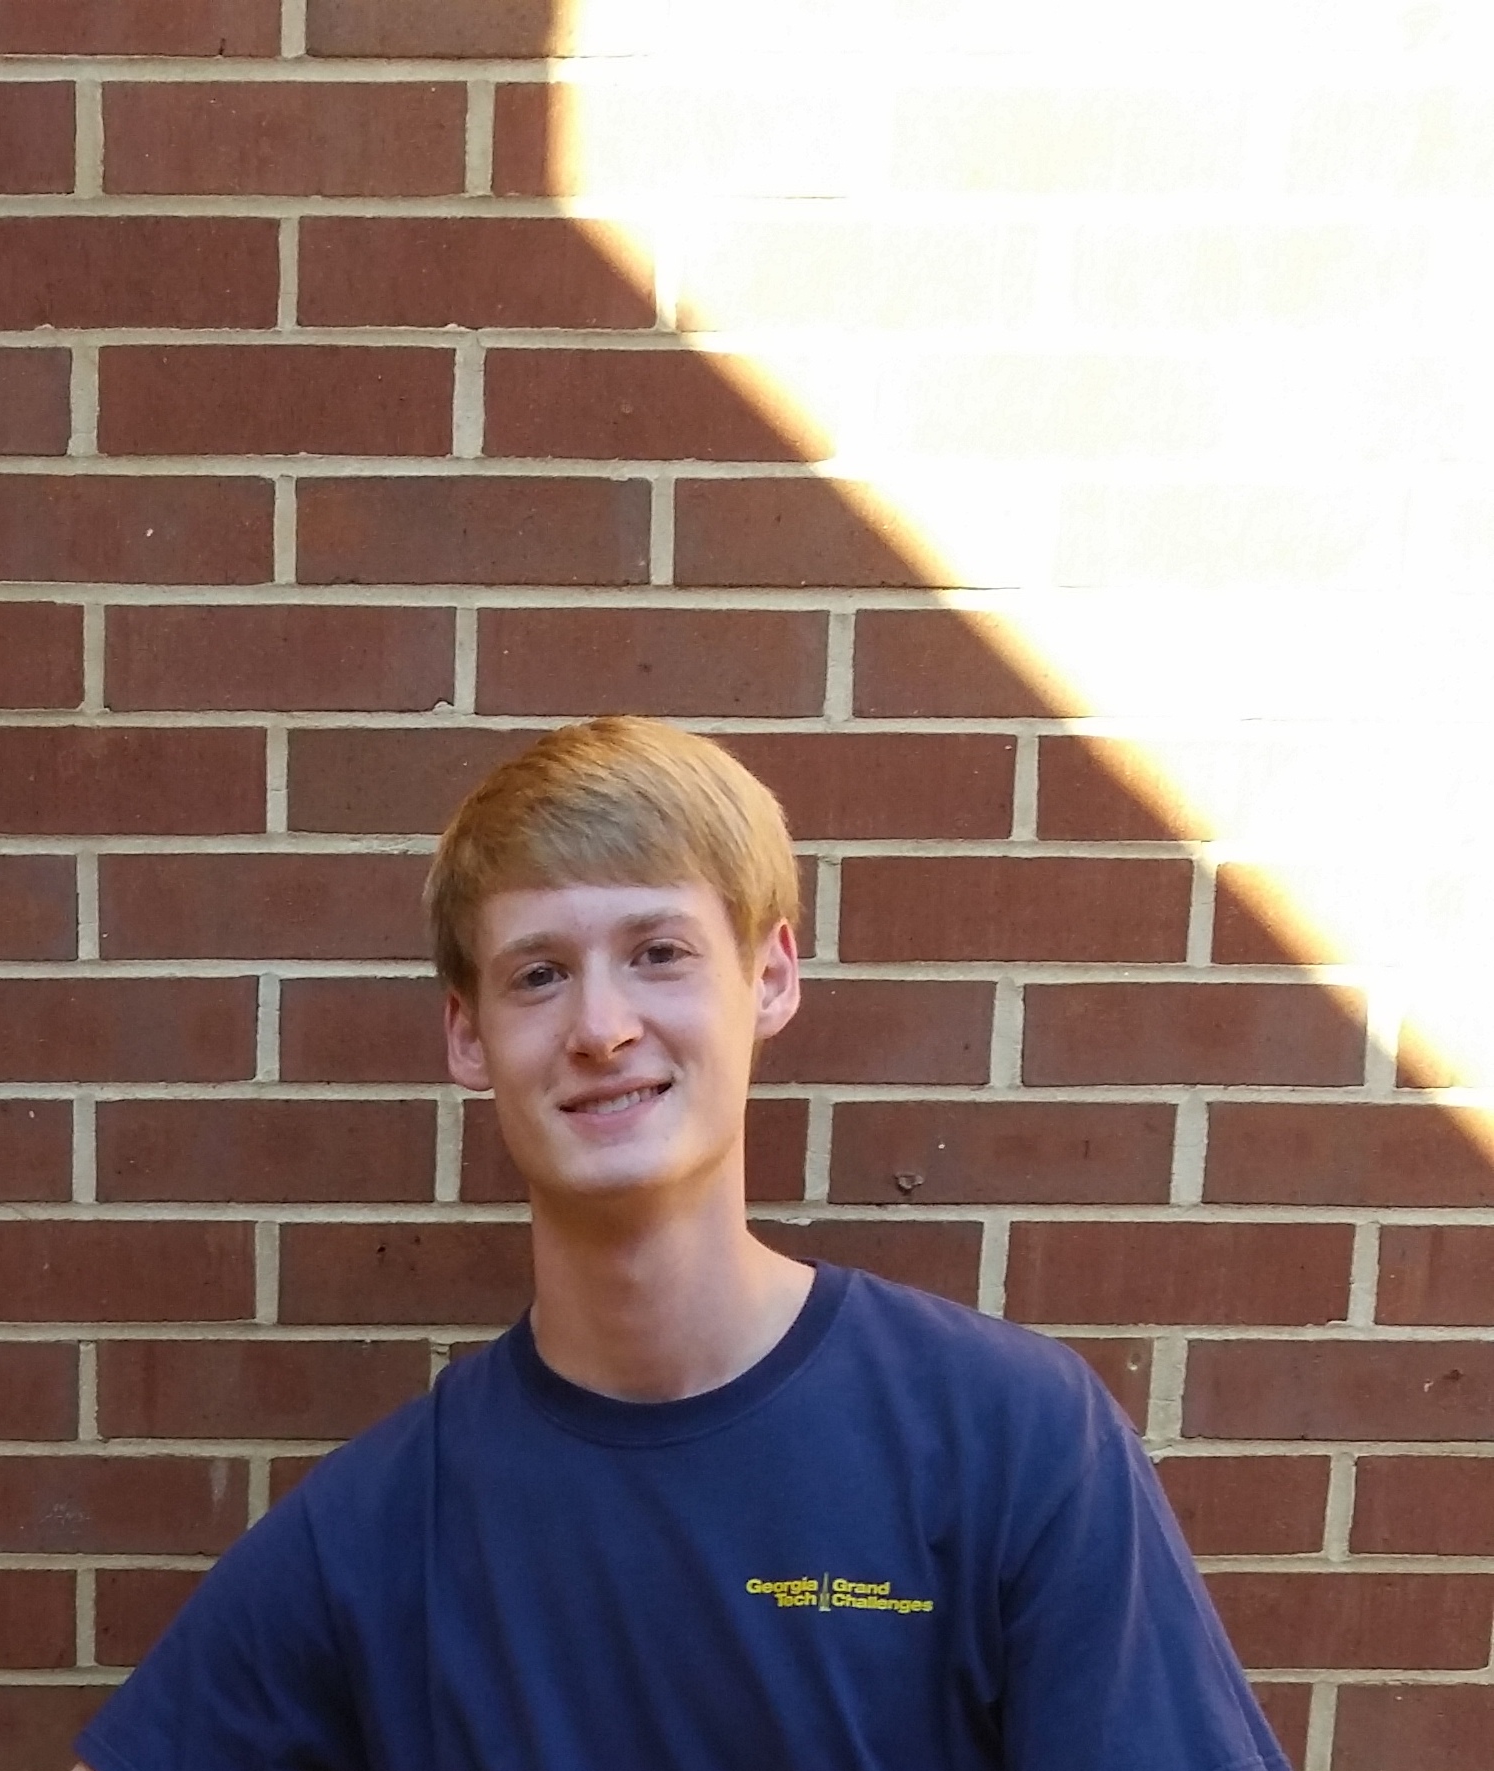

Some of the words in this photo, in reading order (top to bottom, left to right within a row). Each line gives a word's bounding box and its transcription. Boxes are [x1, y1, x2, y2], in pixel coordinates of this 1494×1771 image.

[746, 1577, 818, 1593] Georgia
[832, 1578, 890, 1594] Grand
[776, 1594, 817, 1607] Tech
[832, 1594, 933, 1614] Challenges
